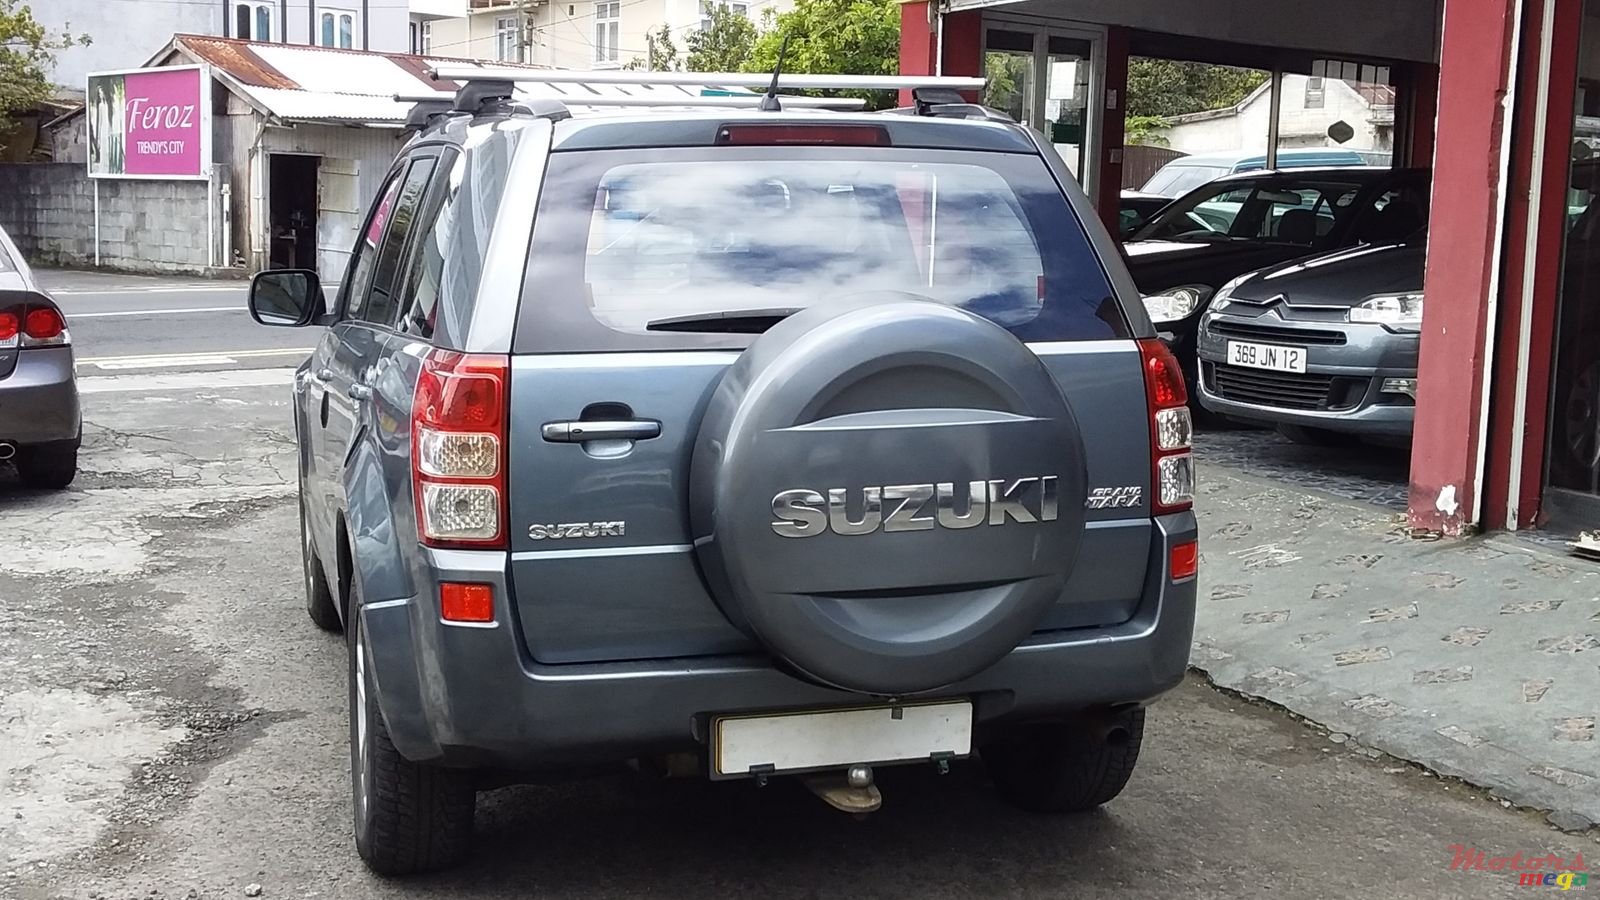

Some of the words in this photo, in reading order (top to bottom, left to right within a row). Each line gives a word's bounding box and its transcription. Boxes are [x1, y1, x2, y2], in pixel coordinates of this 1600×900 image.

[126, 97, 195, 133] Feroz
[137, 141, 168, 154] TRENDY'S
[169, 141, 184, 153] CITY
[1235, 344, 1256, 365] 369
[1260, 347, 1277, 367] JN
[1284, 349, 1299, 370] 12
[771, 475, 1058, 539] SUZUKI
[528, 521, 625, 540] SUZUKI
